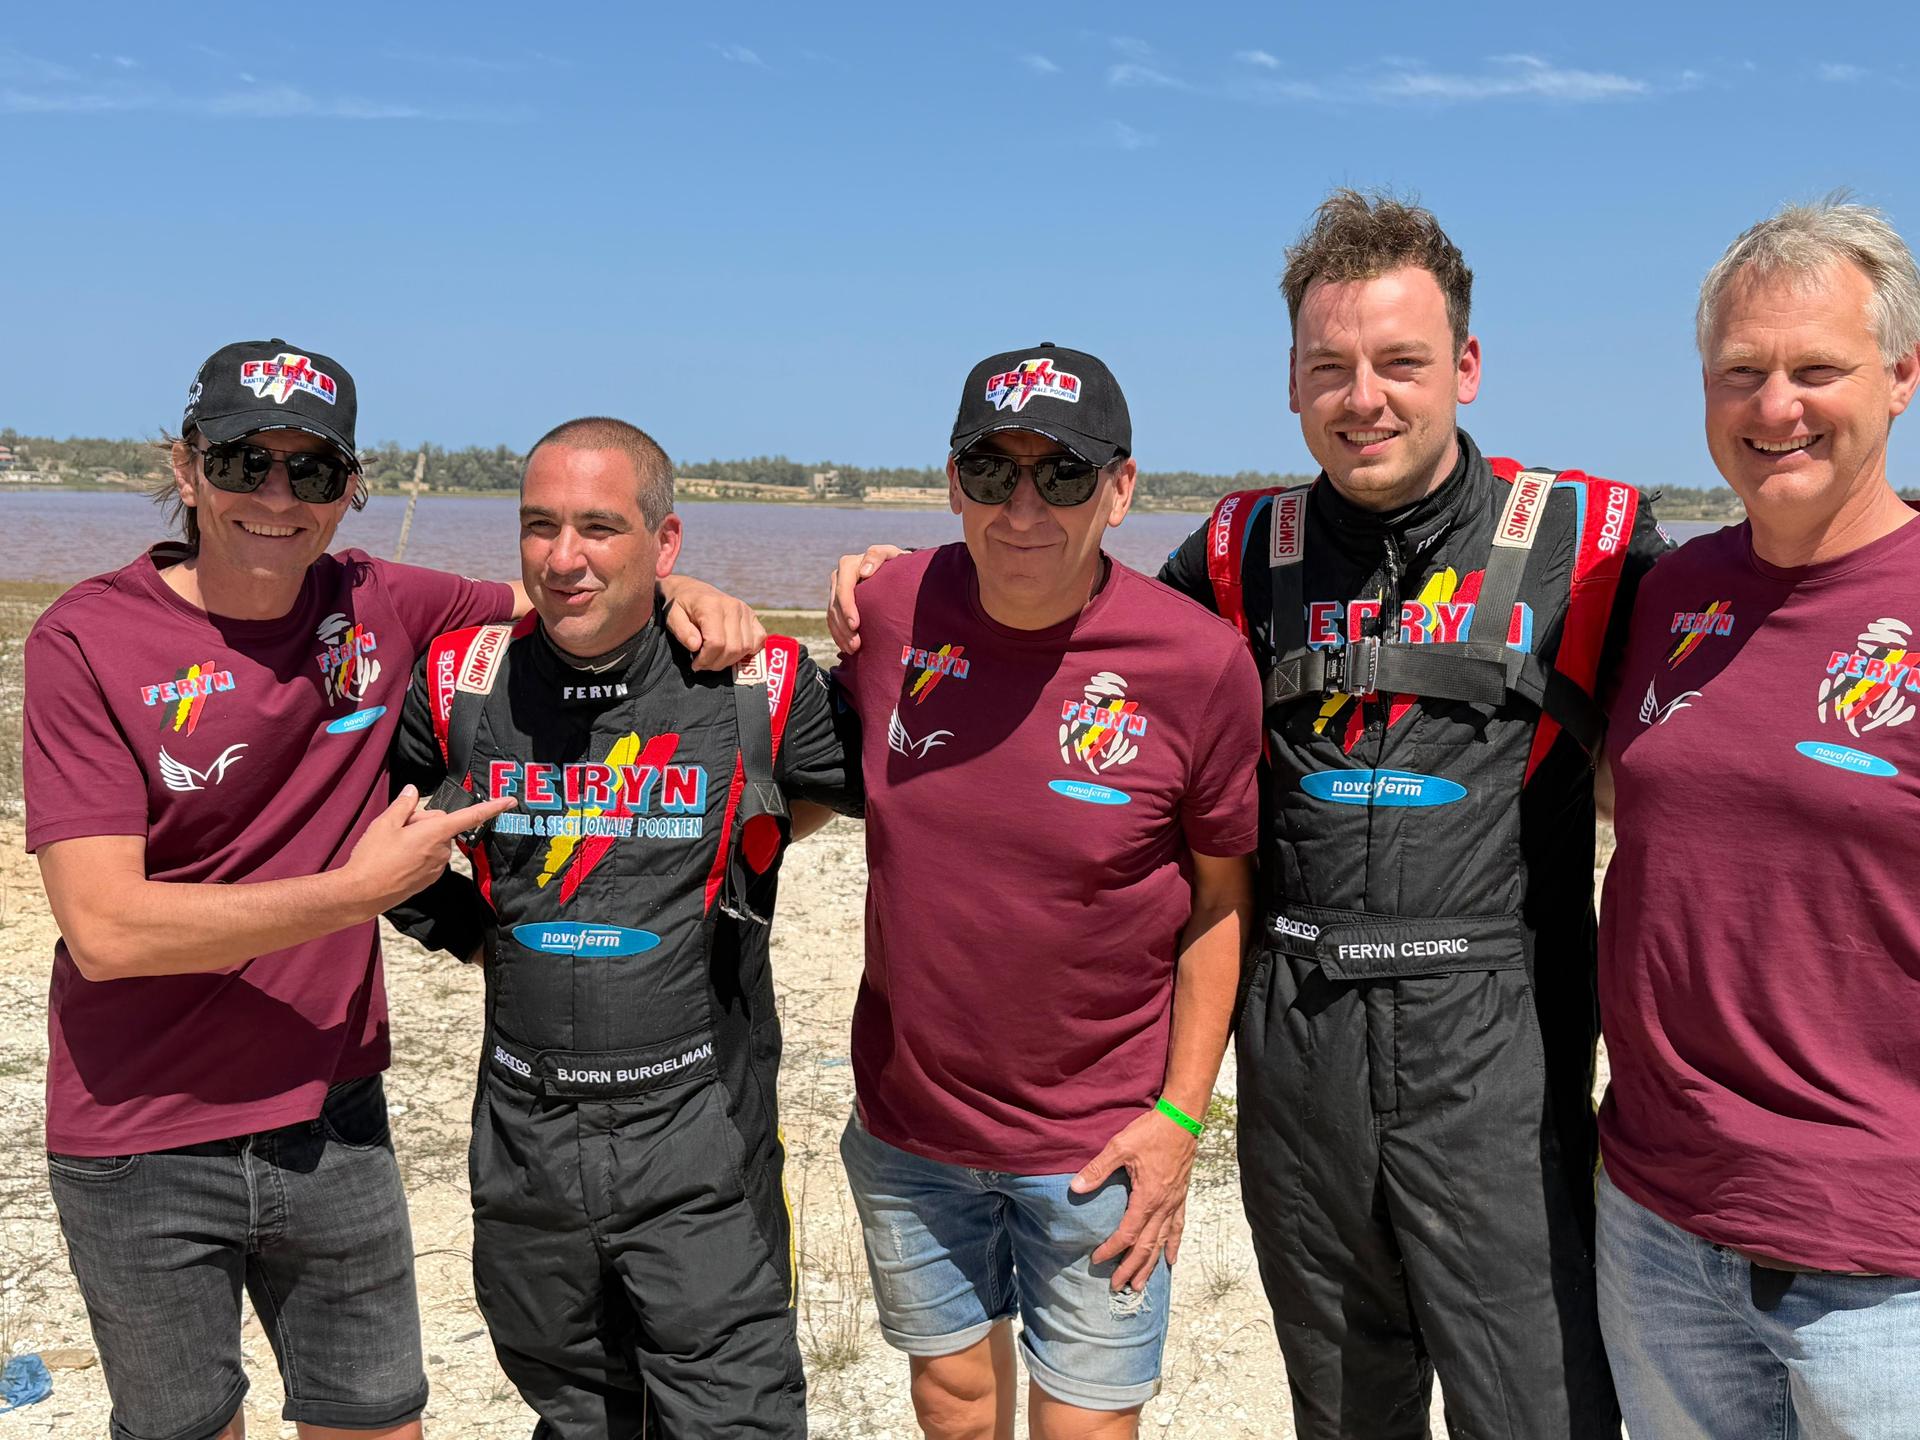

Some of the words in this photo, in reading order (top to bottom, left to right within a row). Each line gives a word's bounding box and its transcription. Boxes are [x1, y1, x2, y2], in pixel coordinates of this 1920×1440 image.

[243, 362, 335, 397] FERYN
[988, 371, 1077, 394] FERYN
[1507, 480, 1541, 539] SIMPSON
[1598, 486, 1628, 554] sparco
[1215, 497, 1240, 558] sparco
[1279, 499, 1298, 555] SIMPSON
[1271, 600, 1534, 654] ERY
[1671, 612, 1735, 636] FERYN
[469, 630, 502, 686] SIMPSON
[901, 645, 970, 679] FERYN
[140, 670, 236, 706] FERYN
[563, 683, 628, 700] FERYN
[1061, 699, 1147, 737] FERYN
[1815, 746, 1871, 769] novoferm
[489, 760, 708, 815] FERYN
[1064, 784, 1112, 799] novoferm
[1331, 776, 1425, 798] novoferm
[495, 813, 533, 835] ANTEL
[534, 815, 546, 837] &
[547, 815, 632, 838] SECTIONALE
[637, 816, 703, 838] POORTEN
[541, 929, 622, 950] novoferm
[1274, 915, 1320, 941] sparco
[1338, 943, 1396, 960] FERYN
[1400, 938, 1469, 957] CEDRIC
[495, 1045, 532, 1078] sparco
[557, 1068, 612, 1083] BJORN
[616, 1042, 713, 1083] BURGELMAN
